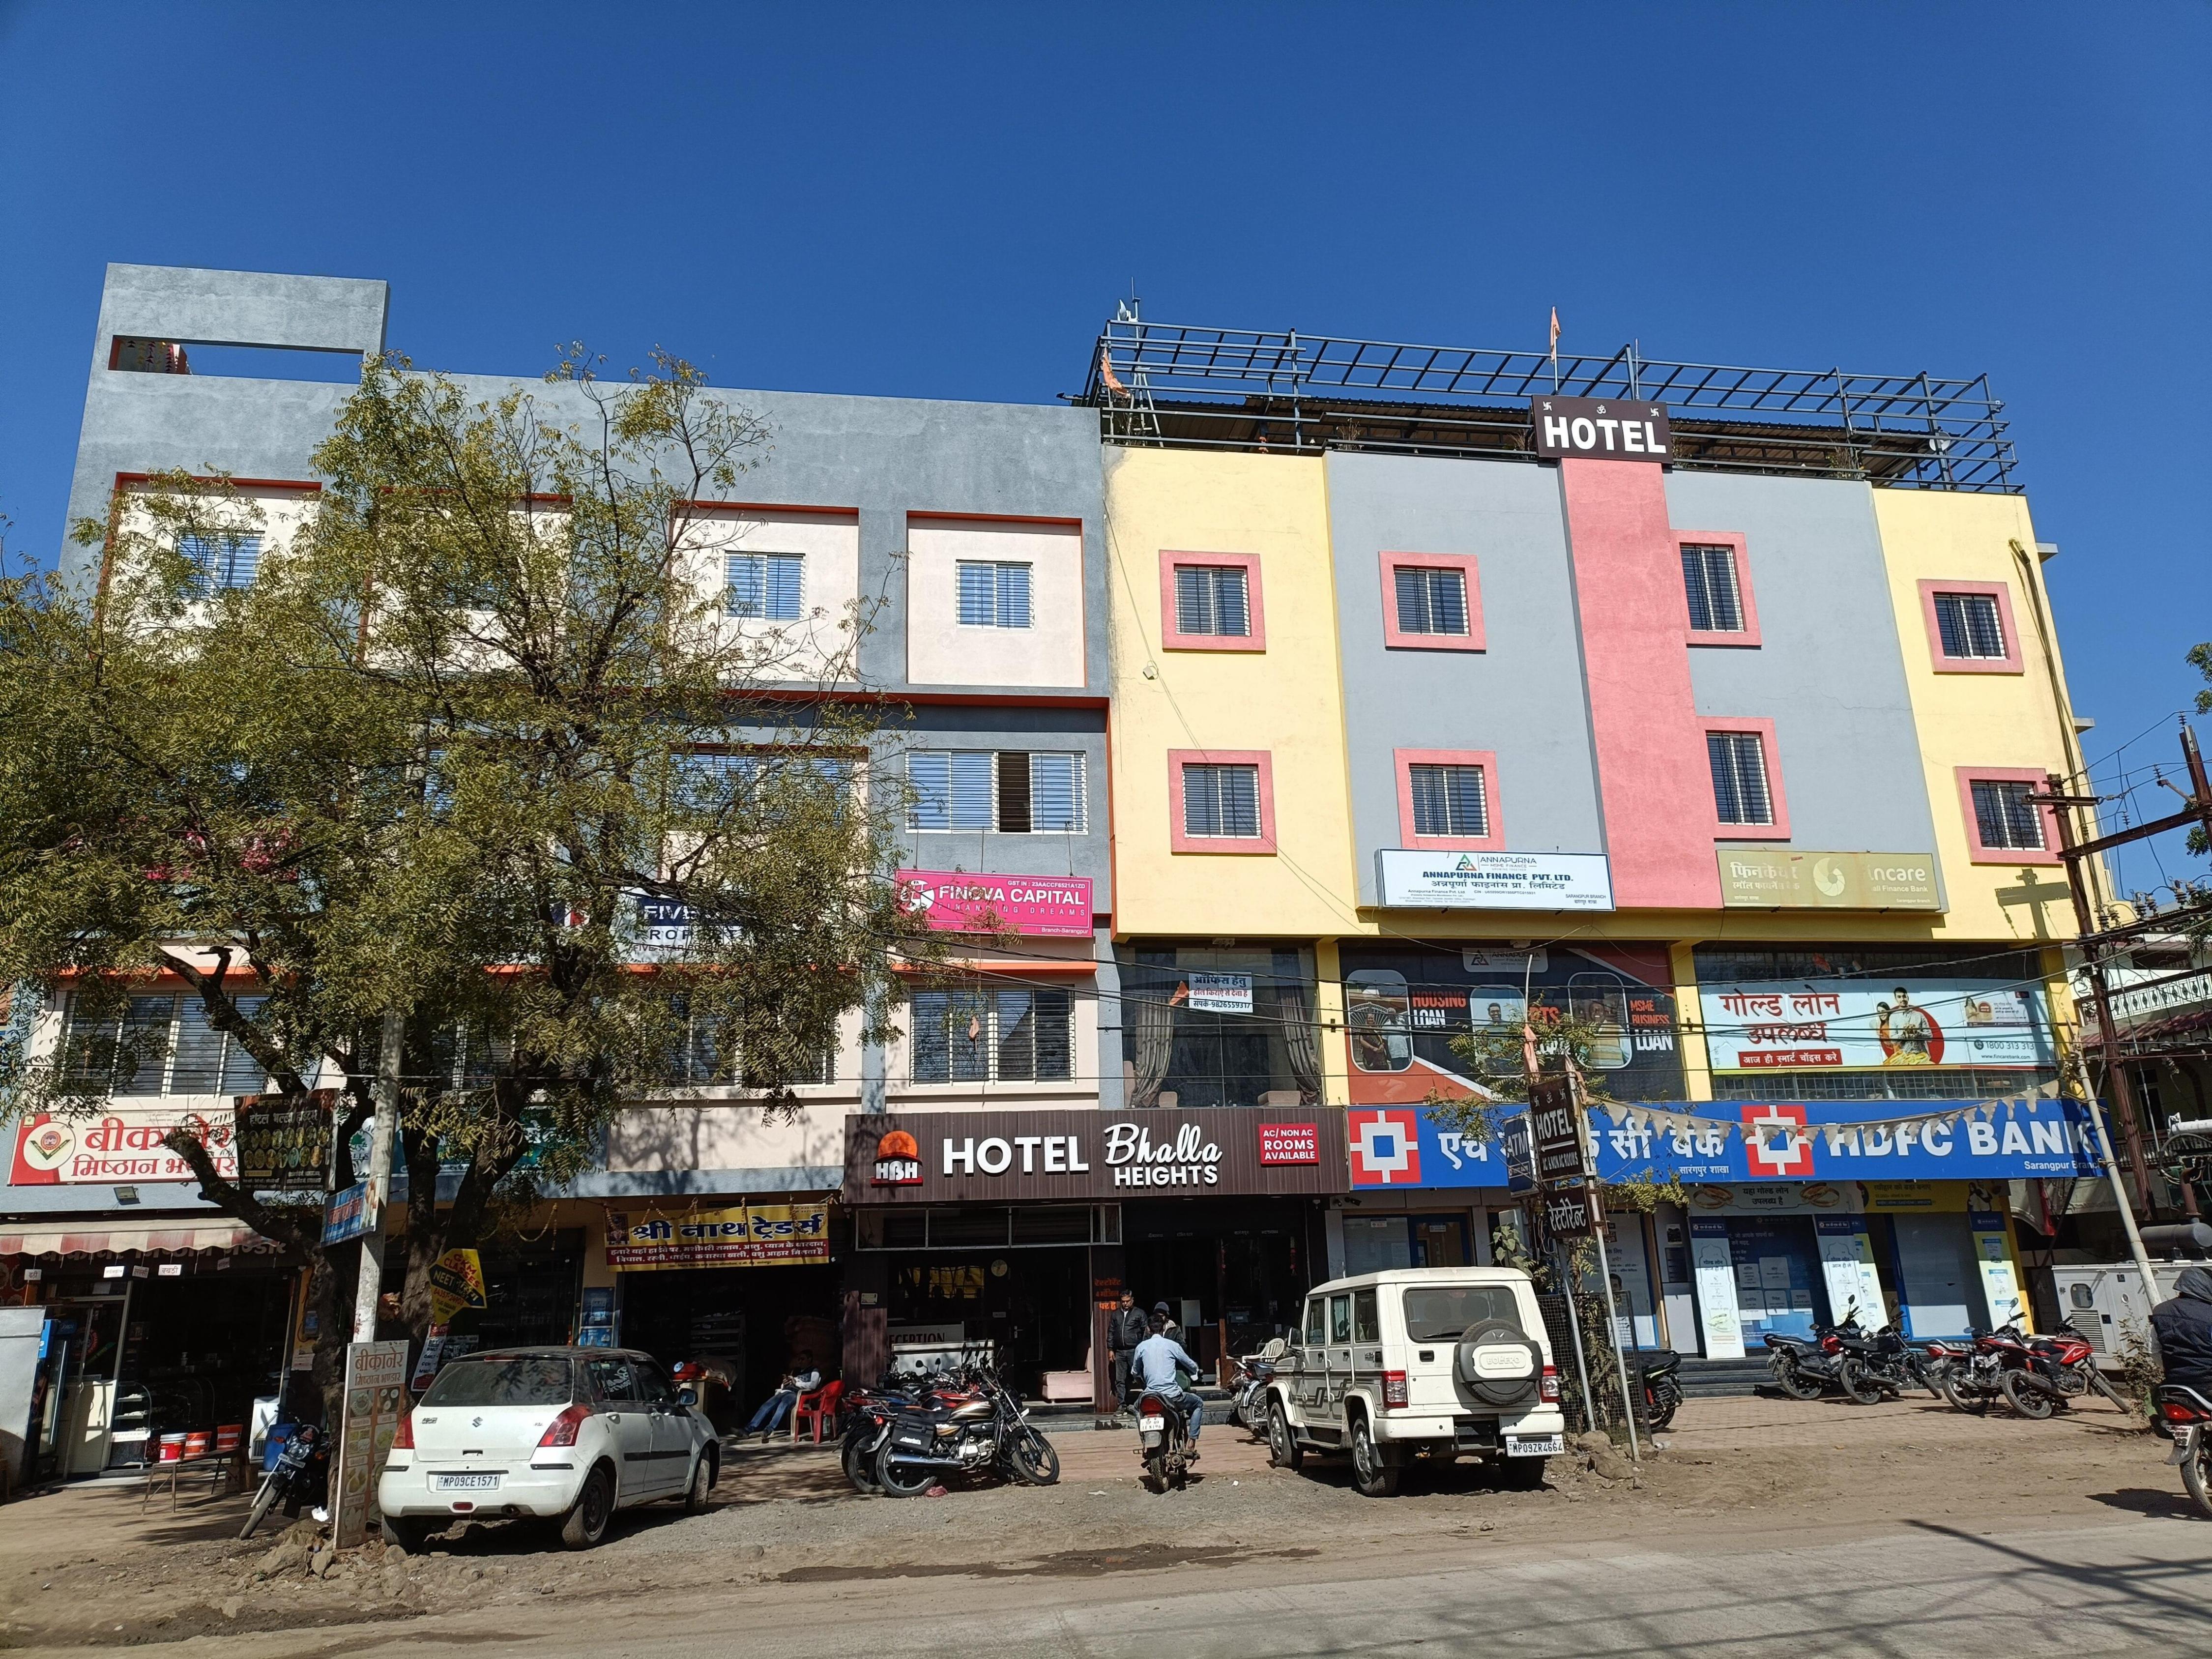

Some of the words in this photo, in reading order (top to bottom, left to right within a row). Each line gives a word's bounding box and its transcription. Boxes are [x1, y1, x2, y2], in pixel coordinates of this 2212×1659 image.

[1543, 416, 1667, 454] HOTEL
[1423, 872, 1484, 880] ANNAPURNA
[1431, 879, 1467, 889] अन्नपूर्णा
[1471, 880, 1508, 889] फाइनांस
[1529, 881, 1565, 890] लिमिटेड
[939, 885, 1005, 902] FINOVA
[1010, 888, 1085, 905] CAPITAL
[1030, 907, 1085, 916] DREAMS
[1412, 991, 1466, 1007] HOUSING
[1630, 999, 1655, 1012] MSME
[1719, 989, 1783, 1017] गोल्ड
[1789, 984, 1840, 1016] लोन
[1414, 1009, 1446, 1027] LOAN
[1632, 1014, 1670, 1025] BUSINESS
[1635, 1028, 1673, 1050] LOAN
[1746, 1021, 1828, 1045] उपलब्ध
[1744, 1055, 1760, 1064] आज
[1764, 1054, 1773, 1064] ही
[1776, 1052, 1796, 1063] स्मार्ट
[1800, 1052, 1821, 1062] चॉइस
[1536, 1107, 1573, 1140] HOTEL
[1264, 1140, 1315, 1151] ROOMS
[1438, 1131, 1487, 1170] एच
[1609, 1117, 1653, 1159] सी
[1507, 1131, 1528, 1158] ATM
[1967, 1120, 2100, 1156] BANK
[943, 1135, 1089, 1175] HOTEL
[1104, 1122, 1223, 1166] Bhalla
[1265, 1150, 1315, 1161] AVAILABLE
[71, 1154, 160, 1176] मिष्ठान
[1679, 1165, 1707, 1177] सारंगपुर
[1709, 1164, 1730, 1174] शाखा
[2024, 1161, 2069, 1171] Sarangpur
[1114, 1164, 1219, 1187] HEIGHTS
[1743, 1187, 1755, 1195] यहां
[1757, 1186, 1774, 1194] गोल्ड
[1775, 1186, 1789, 1194] लोन
[1778, 1196, 1783, 1205] है
[632, 1220, 672, 1240] श्री
[679, 1222, 748, 1238] नाथ
[453, 1253, 477, 1275] GKM
[433, 1270, 455, 1286] NEET
[443, 1257, 480, 1288] CLASSES
[888, 1333, 945, 1348] ECEPTION
[355, 1346, 404, 1371] बीकानेर
[1486, 1355, 1521, 1368] BOLERO
[355, 1373, 380, 1386] मिष्ठान
[381, 1372, 401, 1384] भण्डार
[1513, 1442, 1563, 1453] MP09ZR4664
[443, 1476, 498, 1487] MP09CE1571
